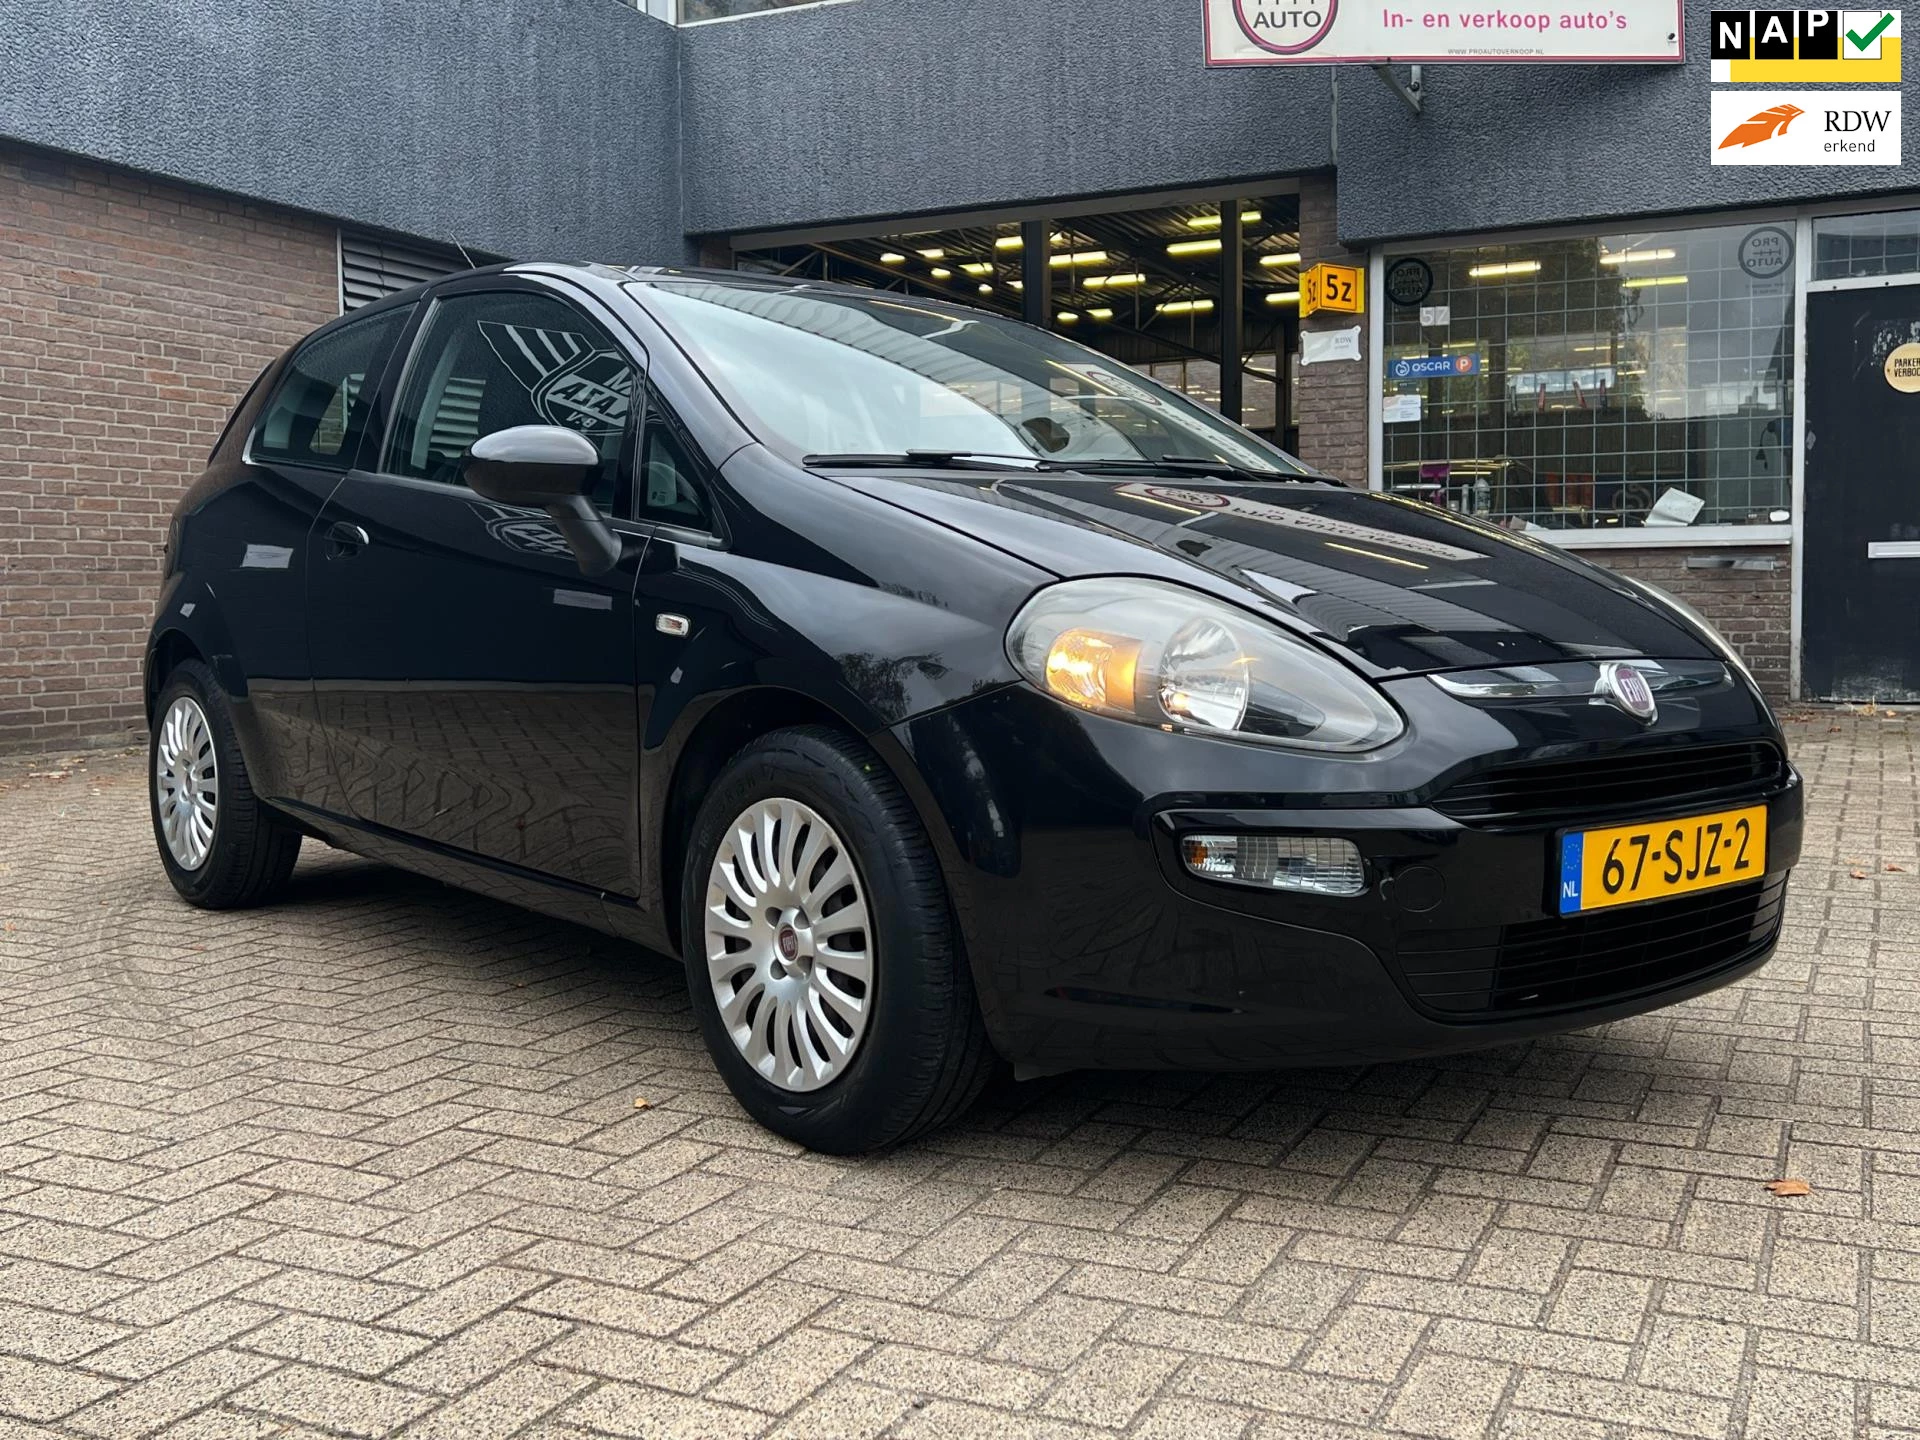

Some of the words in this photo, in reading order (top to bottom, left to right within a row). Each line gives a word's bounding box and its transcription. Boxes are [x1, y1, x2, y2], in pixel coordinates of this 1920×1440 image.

[1253, 10, 1322, 28] AUTO
[1383, 9, 1413, 28] In-
[1422, 12, 1450, 28] en
[1459, 9, 1550, 33] verkoop
[1560, 10, 1627, 29] auto's
[1411, 361, 1451, 372] OSCAR
[1602, 817, 1750, 895] 67-SJZ-2
[1562, 881, 1578, 898] NL
